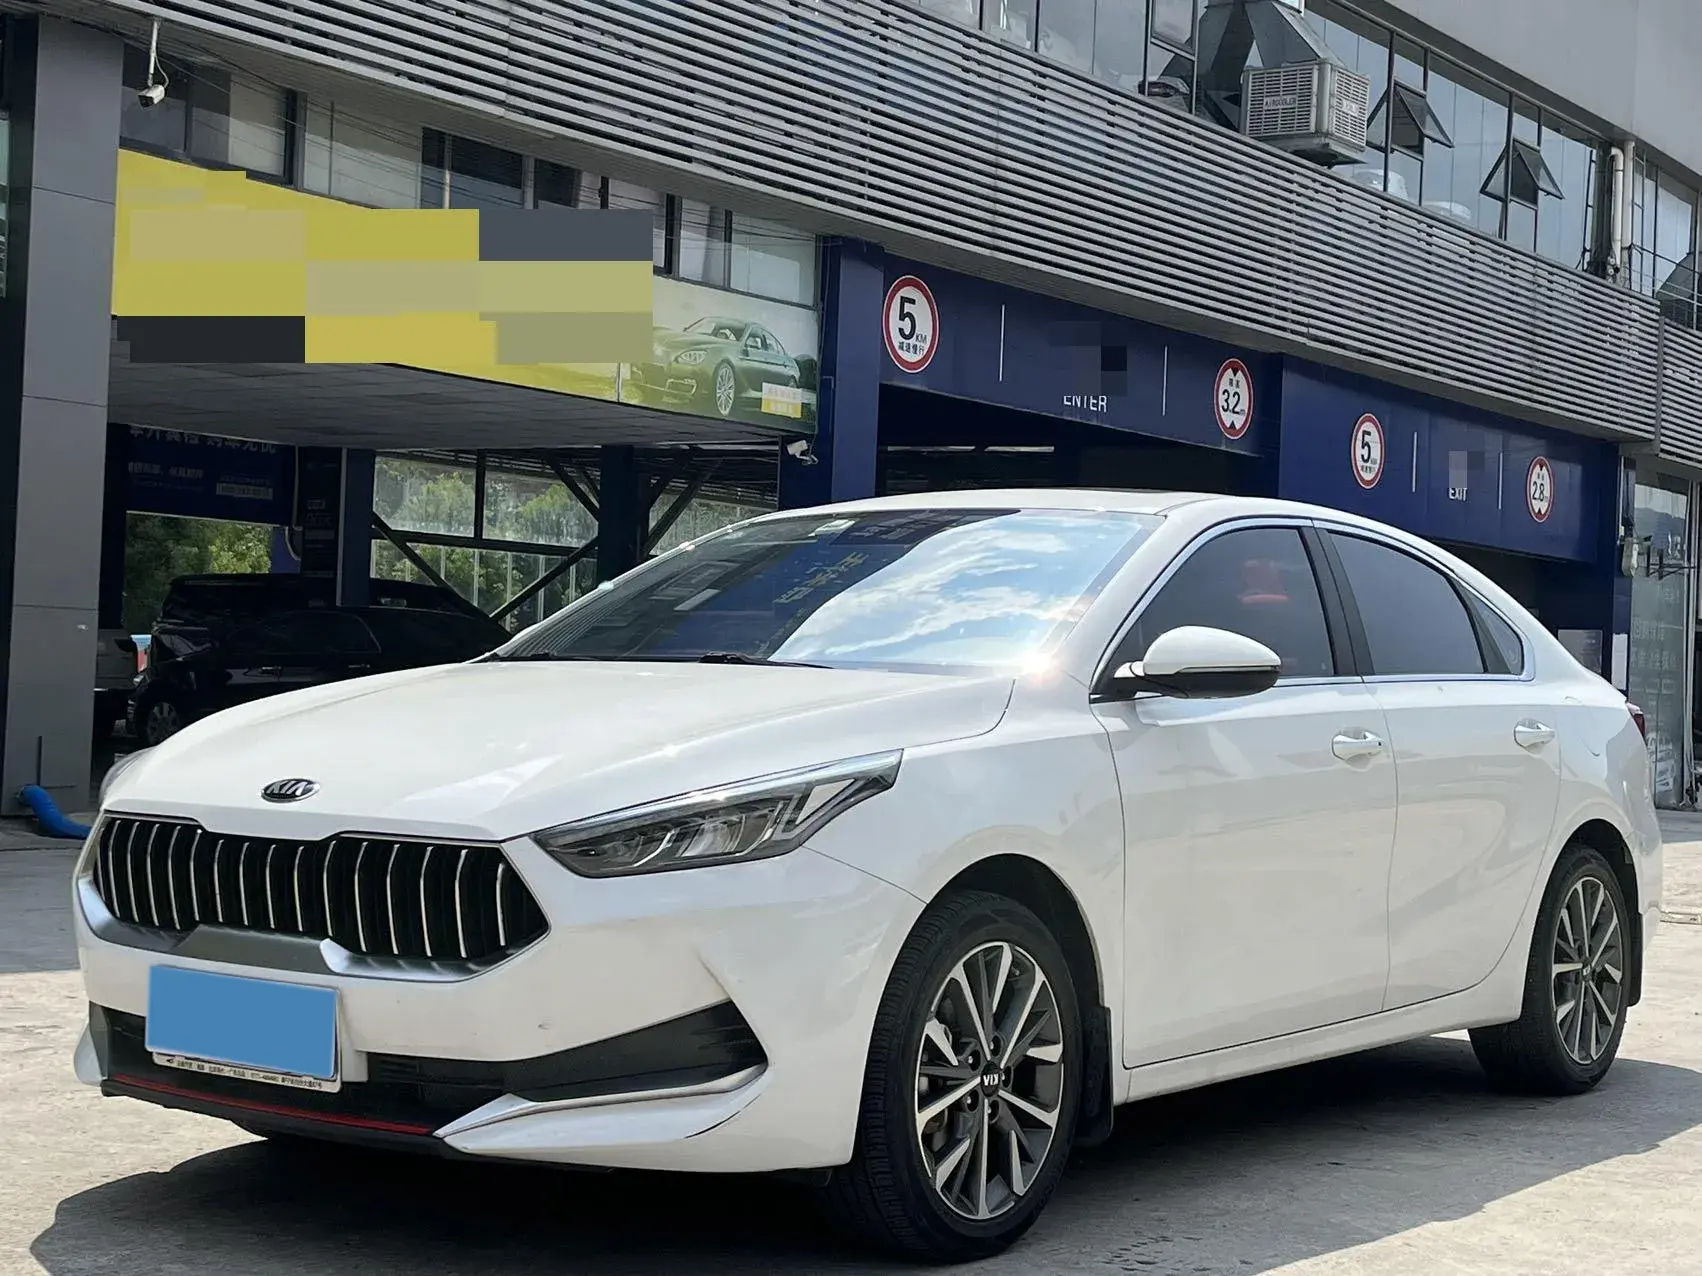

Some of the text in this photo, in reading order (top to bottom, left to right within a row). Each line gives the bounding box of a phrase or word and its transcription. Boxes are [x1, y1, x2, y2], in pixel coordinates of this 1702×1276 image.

[898, 296, 916, 340] 5
[1361, 429, 1371, 463] 5
[1449, 487, 1468, 501] EXIT
[265, 780, 308, 796] KIA
